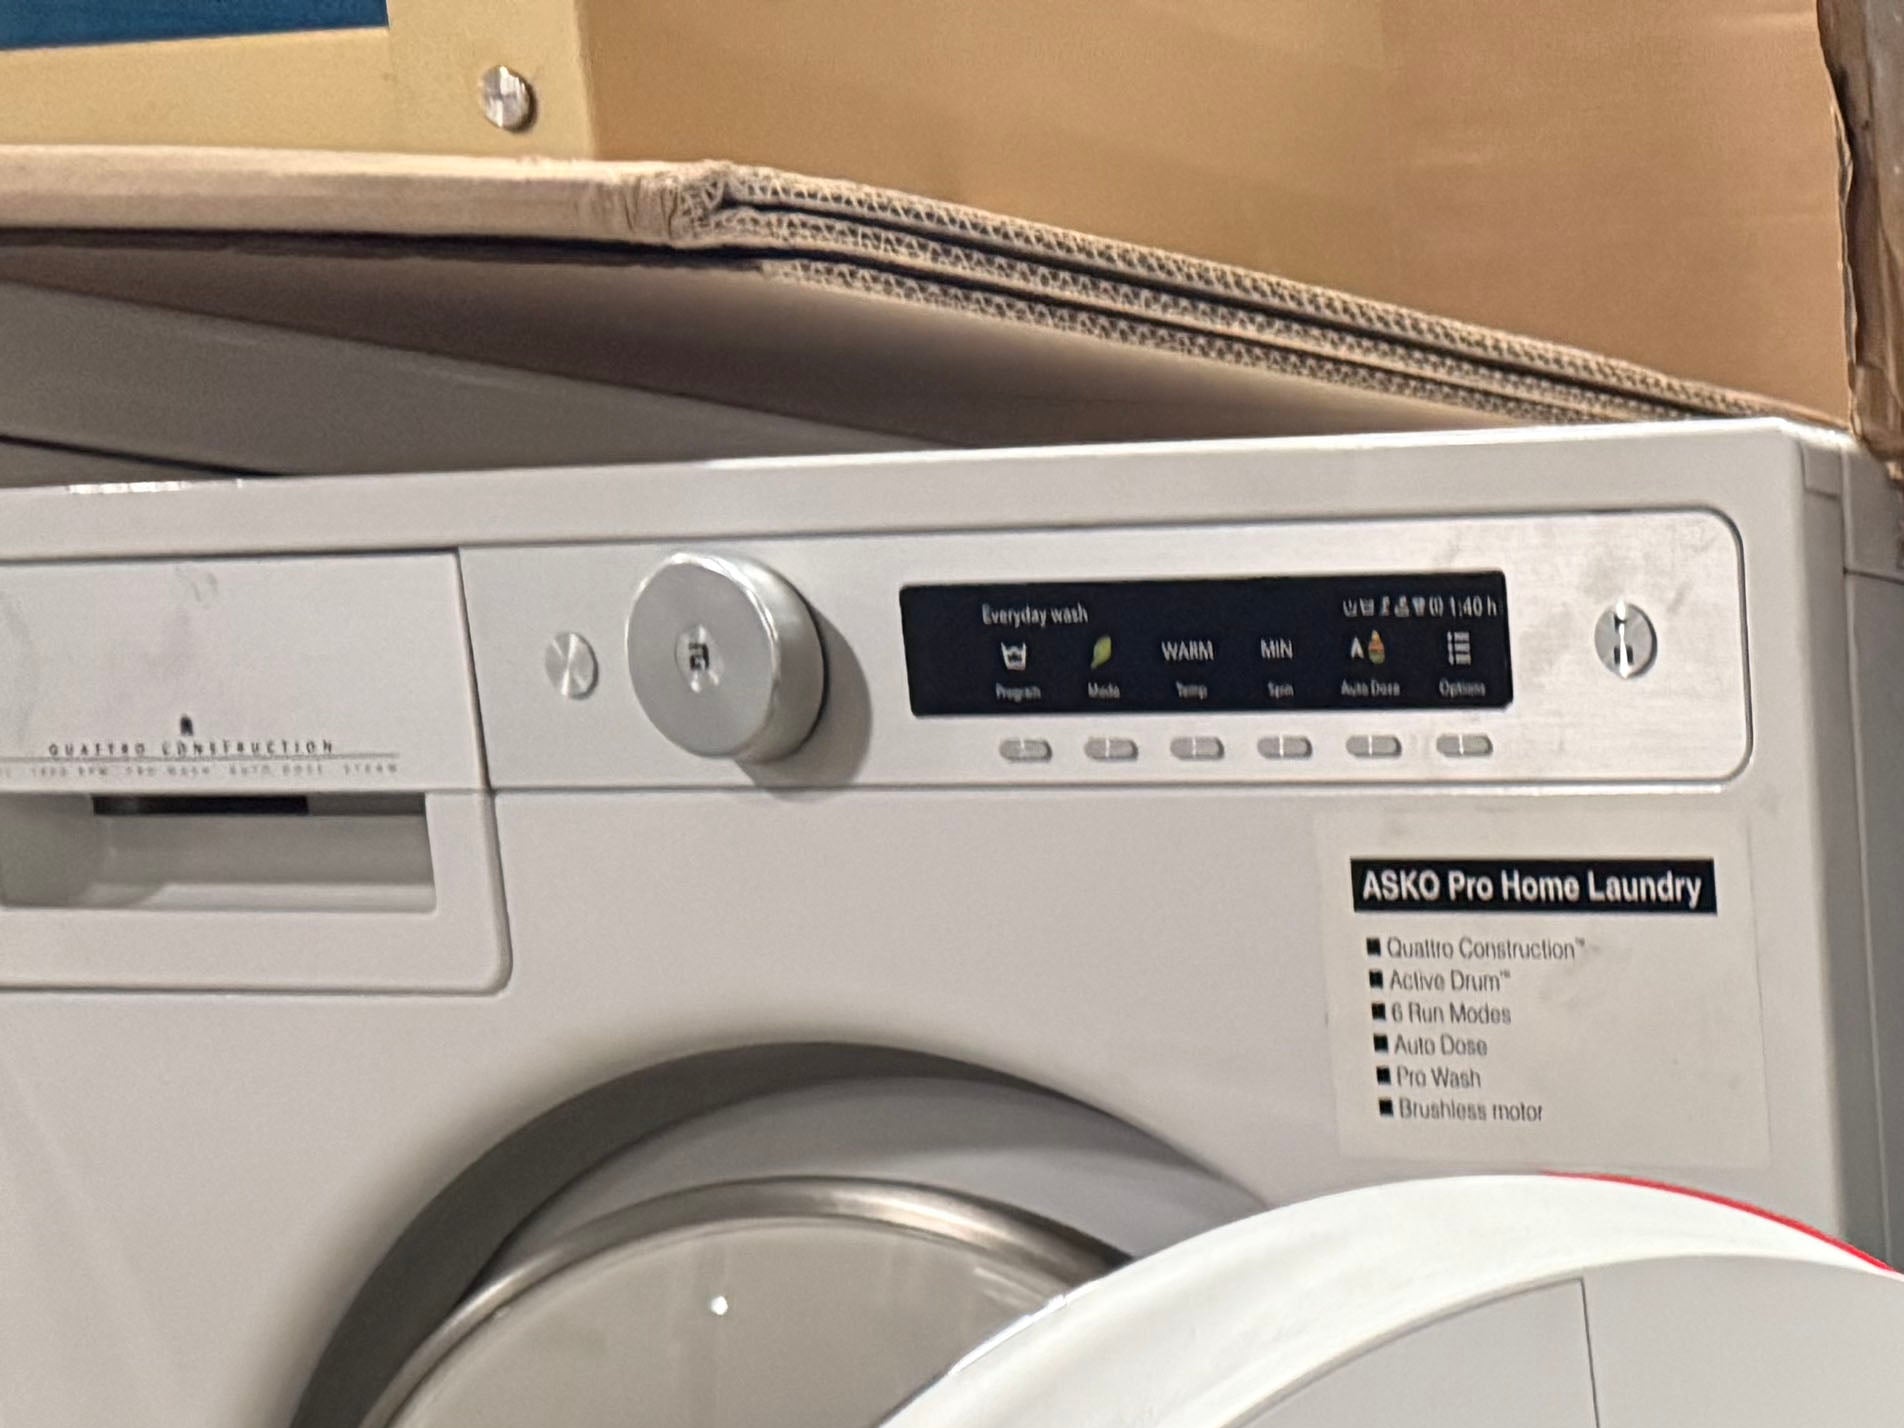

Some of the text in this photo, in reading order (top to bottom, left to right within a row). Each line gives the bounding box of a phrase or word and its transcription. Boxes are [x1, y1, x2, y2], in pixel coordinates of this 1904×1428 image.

[982, 602, 1088, 628] Everyday wash
[1451, 595, 1482, 617] 1:40
[1161, 640, 1214, 661] WARM
[1260, 638, 1293, 659] MIN
[1439, 677, 1486, 697] Options
[1363, 869, 1702, 908] ASKO Pro Home Laundry
[1387, 937, 1454, 960] Quattro
[1389, 969, 1445, 991] Active
[1392, 1003, 1511, 1024] 6 Run Modes
[1394, 1034, 1488, 1056] Auto Dose
[1397, 1066, 1481, 1089] Pro Wash
[1399, 1098, 1543, 1122] Brushless motor
